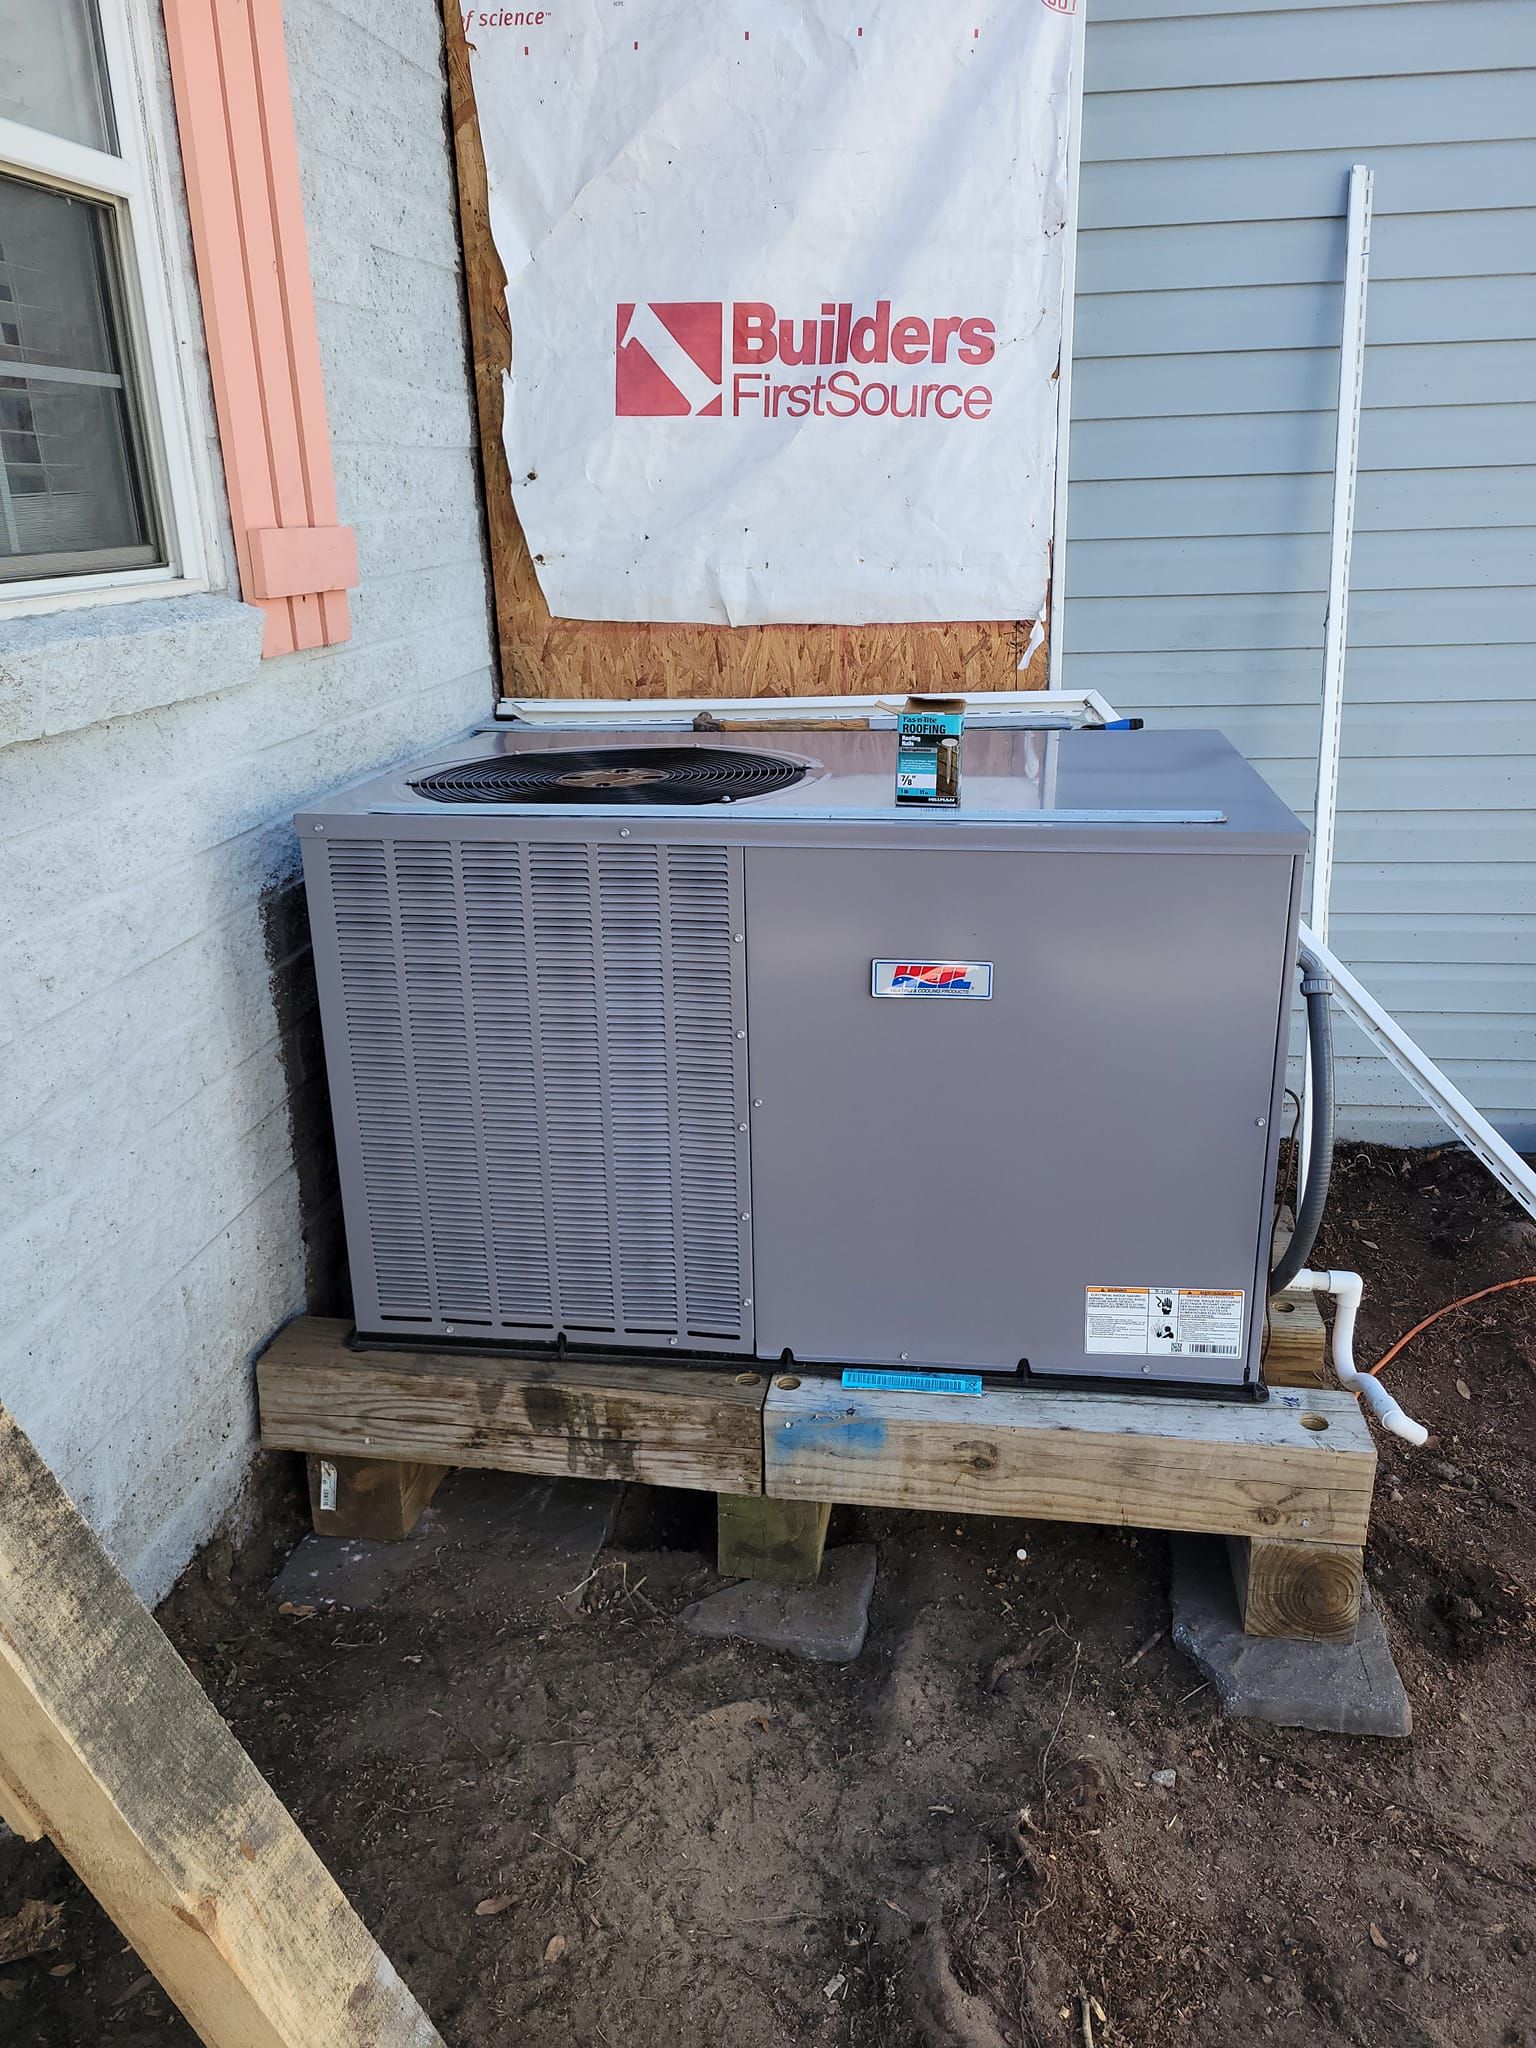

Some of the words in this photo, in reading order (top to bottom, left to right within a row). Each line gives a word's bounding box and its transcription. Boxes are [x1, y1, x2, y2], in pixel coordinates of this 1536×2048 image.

[733, 300, 996, 364] Builders
[733, 370, 993, 418] FirstSource
[902, 724, 946, 734] ROOFING
